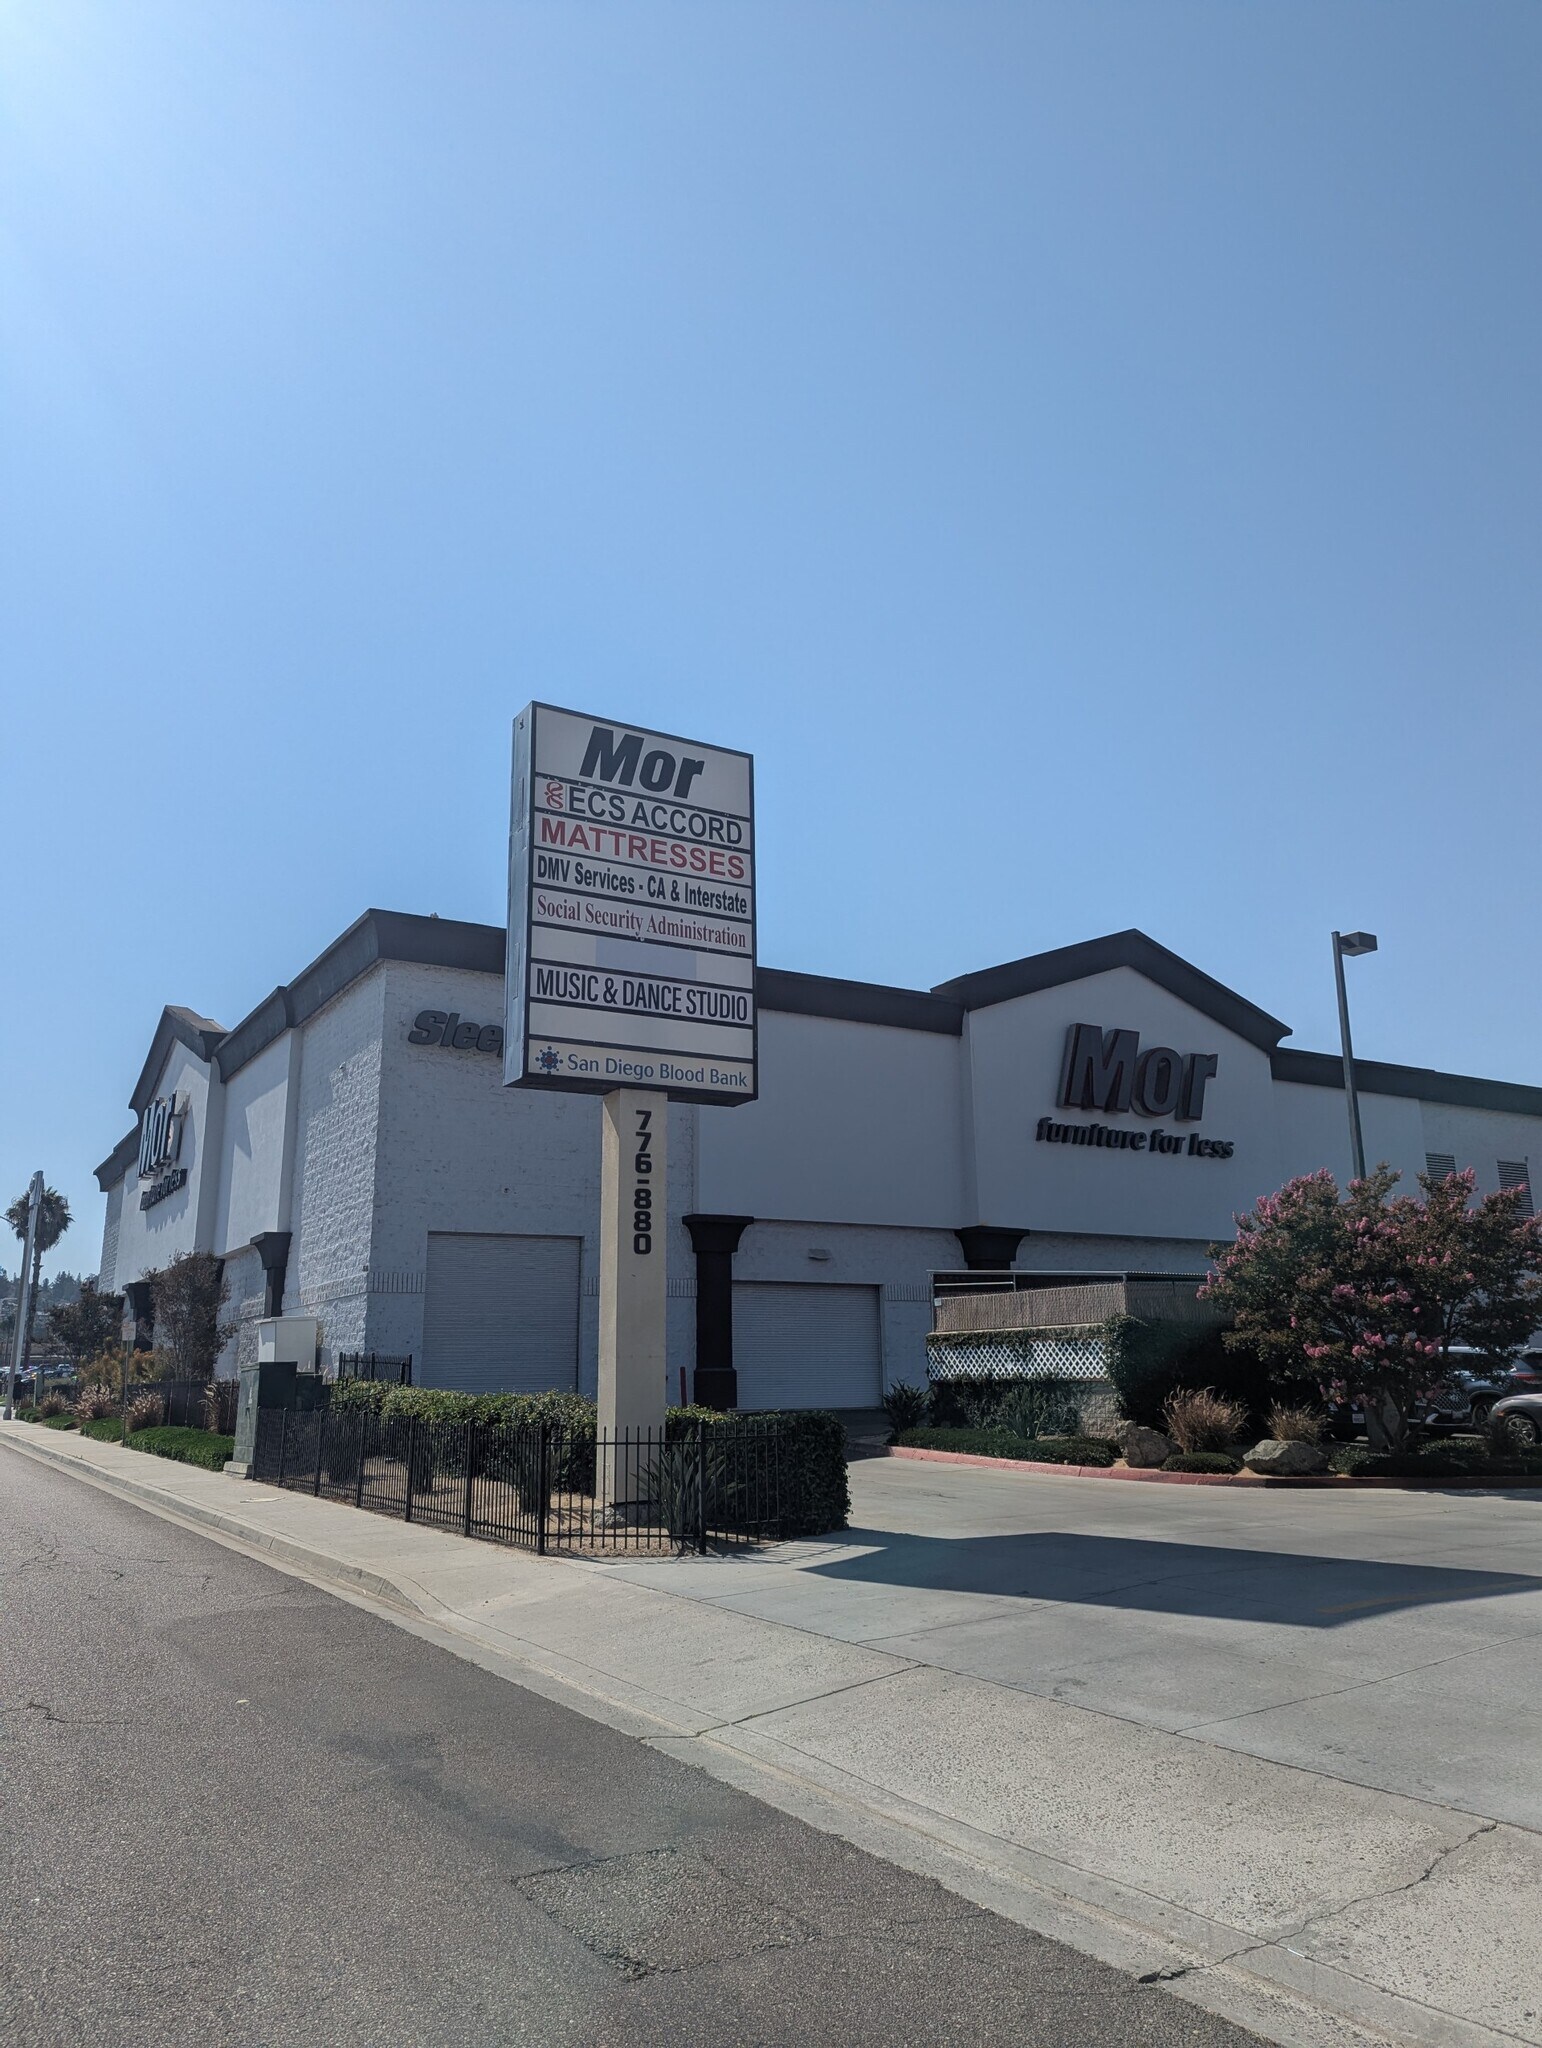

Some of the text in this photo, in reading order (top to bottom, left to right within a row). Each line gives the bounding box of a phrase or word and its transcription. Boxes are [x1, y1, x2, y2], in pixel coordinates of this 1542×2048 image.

[578, 726, 705, 799] Mor
[569, 786, 742, 845] ECS ACCORD
[541, 817, 745, 880] MATTRESSES
[537, 855, 571, 883] DMV
[574, 861, 635, 893] Services
[647, 875, 666, 900] CA
[670, 882, 680, 902] &
[684, 882, 747, 914] Interstate
[537, 894, 747, 948] Social Security Administration
[536, 967, 748, 1021] MUSIC & DANCE STUDIO
[408, 1009, 503, 1058] Slee
[567, 1053, 747, 1087] San Diego Blood Bank
[1056, 1022, 1219, 1122] Mor
[1035, 1116, 1235, 1159] furniture for less
[633, 1110, 652, 1255] 776-880
